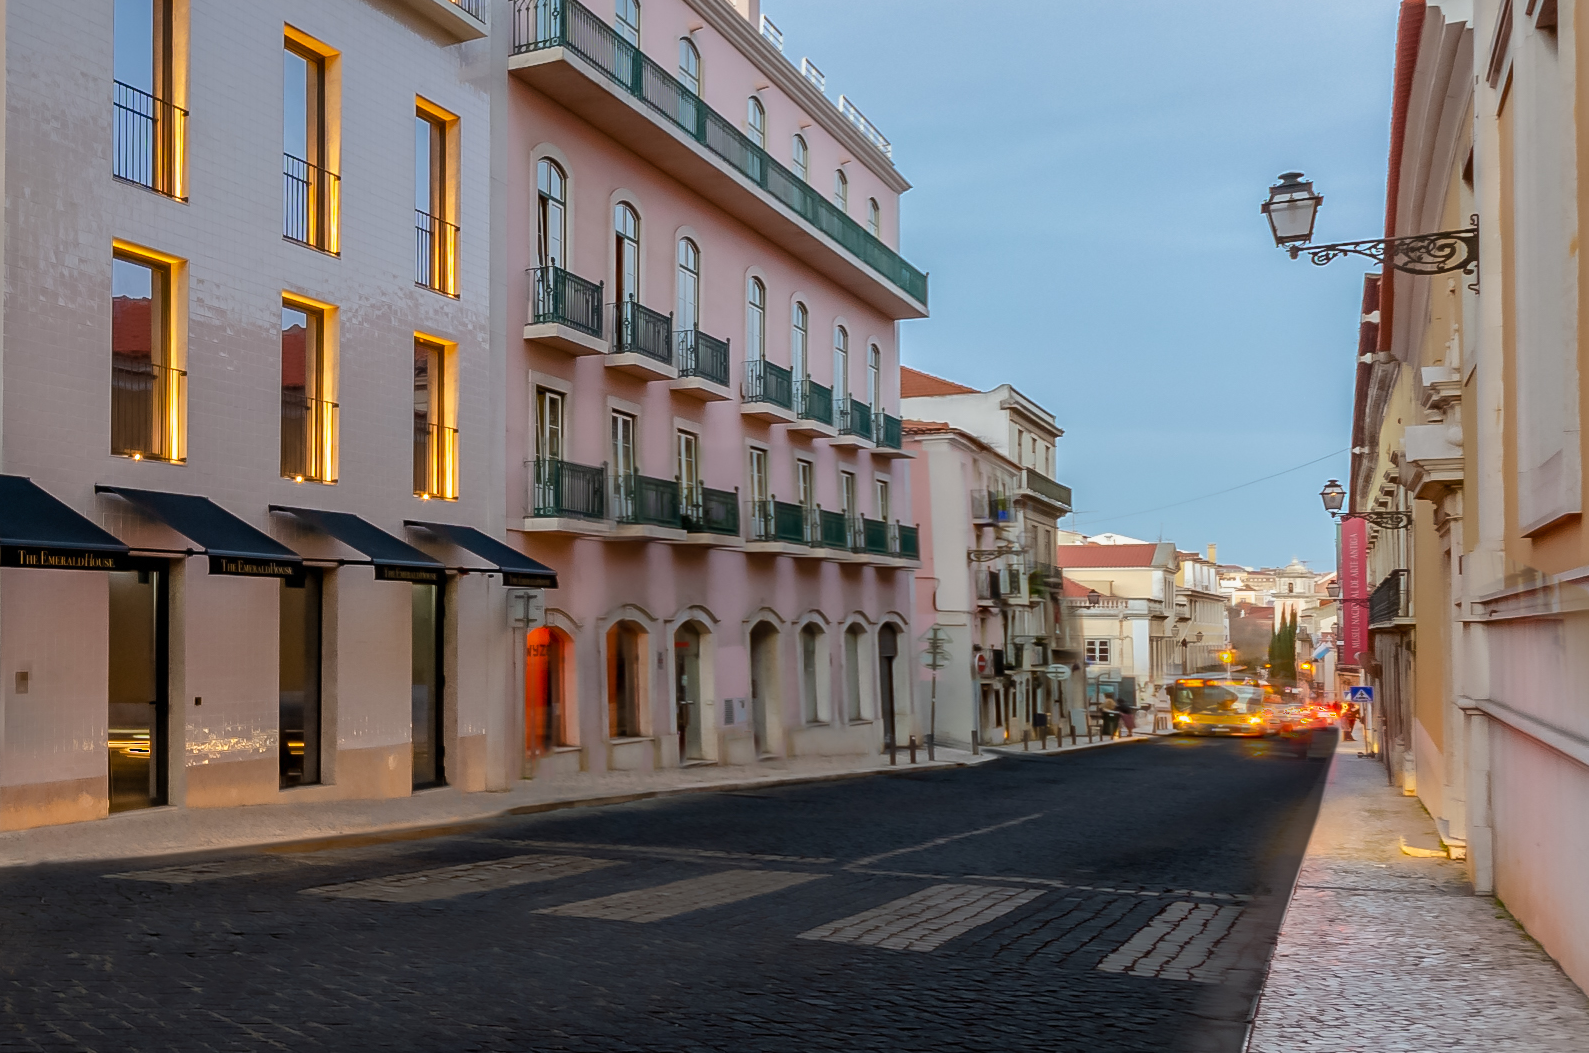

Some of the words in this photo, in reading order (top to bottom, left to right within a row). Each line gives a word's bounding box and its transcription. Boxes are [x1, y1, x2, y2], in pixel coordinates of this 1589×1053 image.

[1349, 533, 1359, 559] ANTIGA
[18, 549, 40, 565] THE
[1350, 561, 1359, 578] ARTE
[1350, 579, 1360, 589] DE
[1351, 627, 1361, 649] MUSEU
